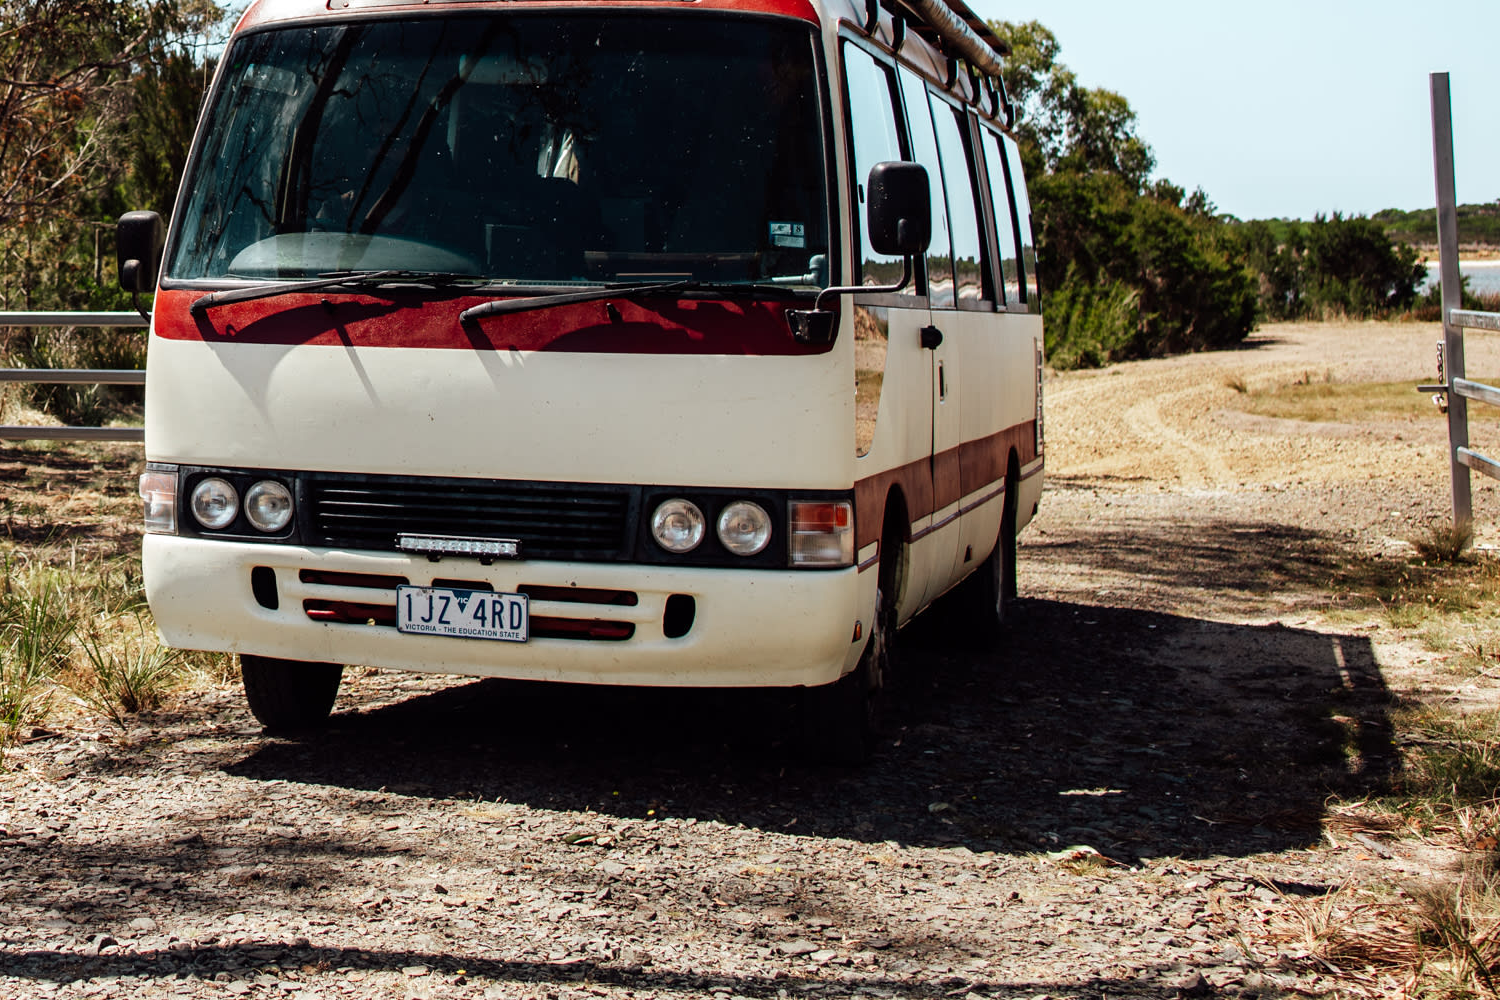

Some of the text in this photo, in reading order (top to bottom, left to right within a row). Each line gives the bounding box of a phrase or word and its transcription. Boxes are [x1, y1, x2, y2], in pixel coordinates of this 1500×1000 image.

[405, 593, 523, 630] 1JZ 4RD
[405, 623, 437, 632] VICTORIA
[444, 626, 457, 634] THE
[458, 627, 498, 637] EDUCATION
[499, 630, 520, 639] STATE
